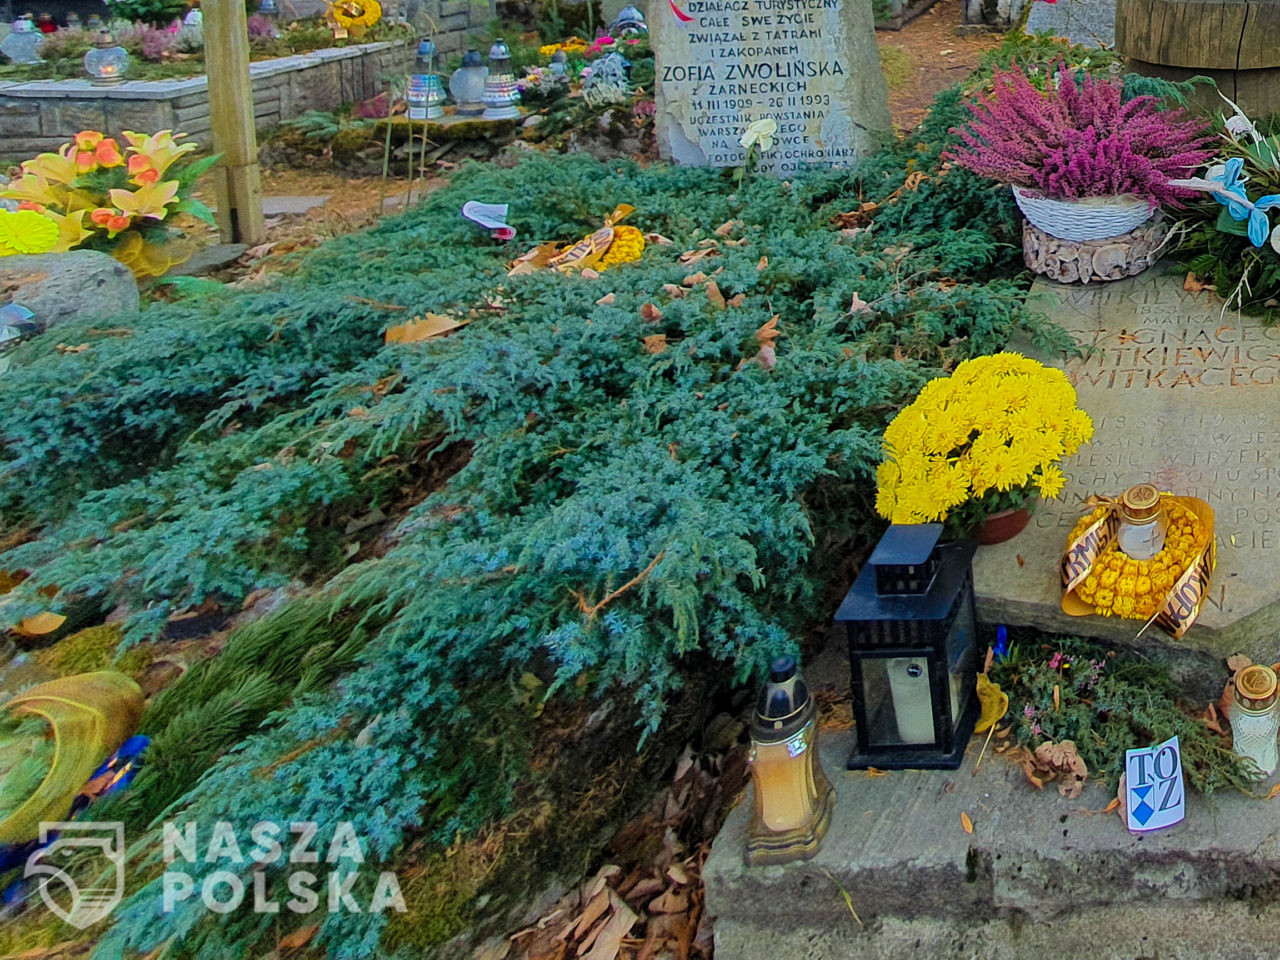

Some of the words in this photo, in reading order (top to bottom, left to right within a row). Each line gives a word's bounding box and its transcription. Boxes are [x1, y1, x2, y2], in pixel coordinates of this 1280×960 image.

[688, 0, 749, 13] DZIAŁACZ
[699, 16, 730, 28] CAŁE
[741, 15, 772, 27] SWE
[688, 32, 747, 45] ZWIĄZAŁ
[765, 28, 822, 41] TATRAMI
[719, 45, 799, 58] ZAKOPANEM
[662, 65, 715, 82] ZOFIA
[725, 59, 844, 81] ZWOLIŃSKA
[723, 98, 753, 110] 1909
[769, 97, 783, 108] 26
[800, 94, 830, 106] 1993
[689, 113, 752, 125] UCZESTNIK
[712, 140, 729, 149] NA
[1143, 314, 1214, 325] MATKA
